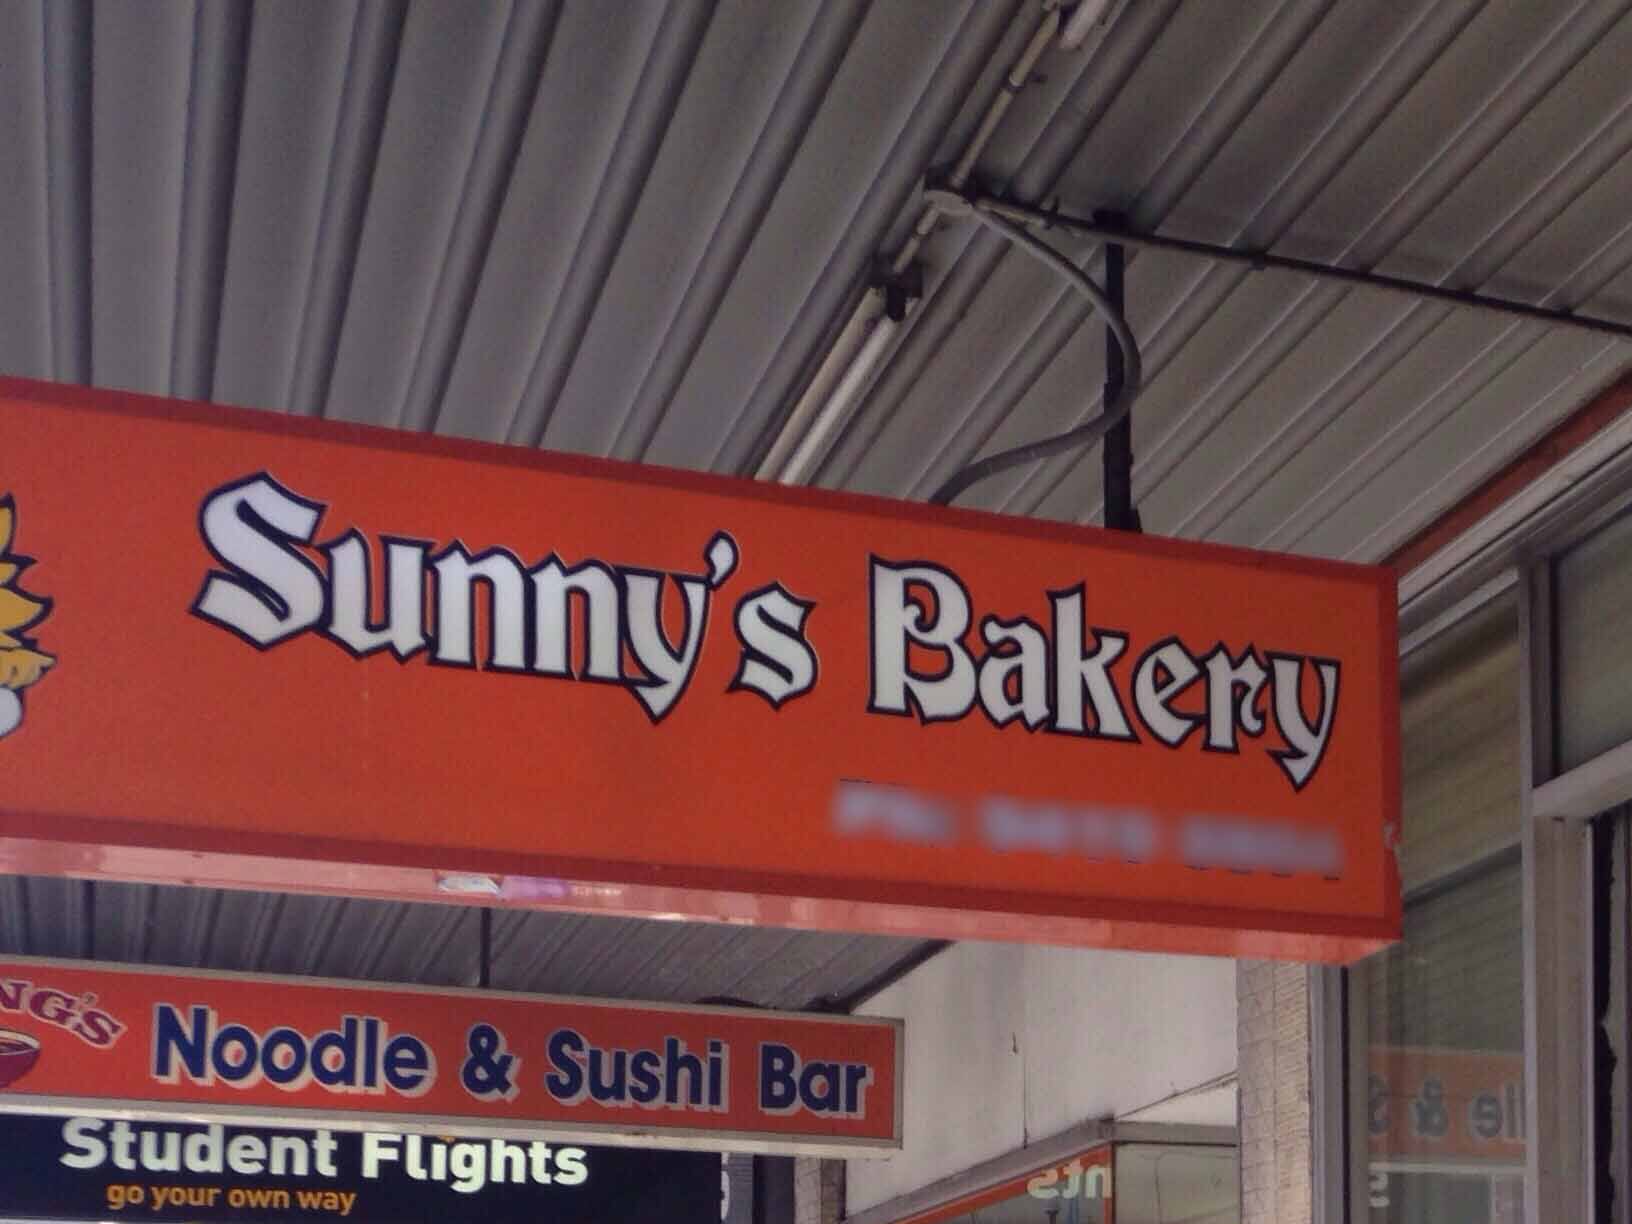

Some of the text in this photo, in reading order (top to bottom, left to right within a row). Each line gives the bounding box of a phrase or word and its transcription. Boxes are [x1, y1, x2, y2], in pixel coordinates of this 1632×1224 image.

[190, 471, 1341, 794] Sunny's Bakery
[151, 1002, 875, 1120] Noodle & Sushi Bar
[59, 1117, 591, 1193] Student Flights
[107, 1184, 358, 1217] go your own way
